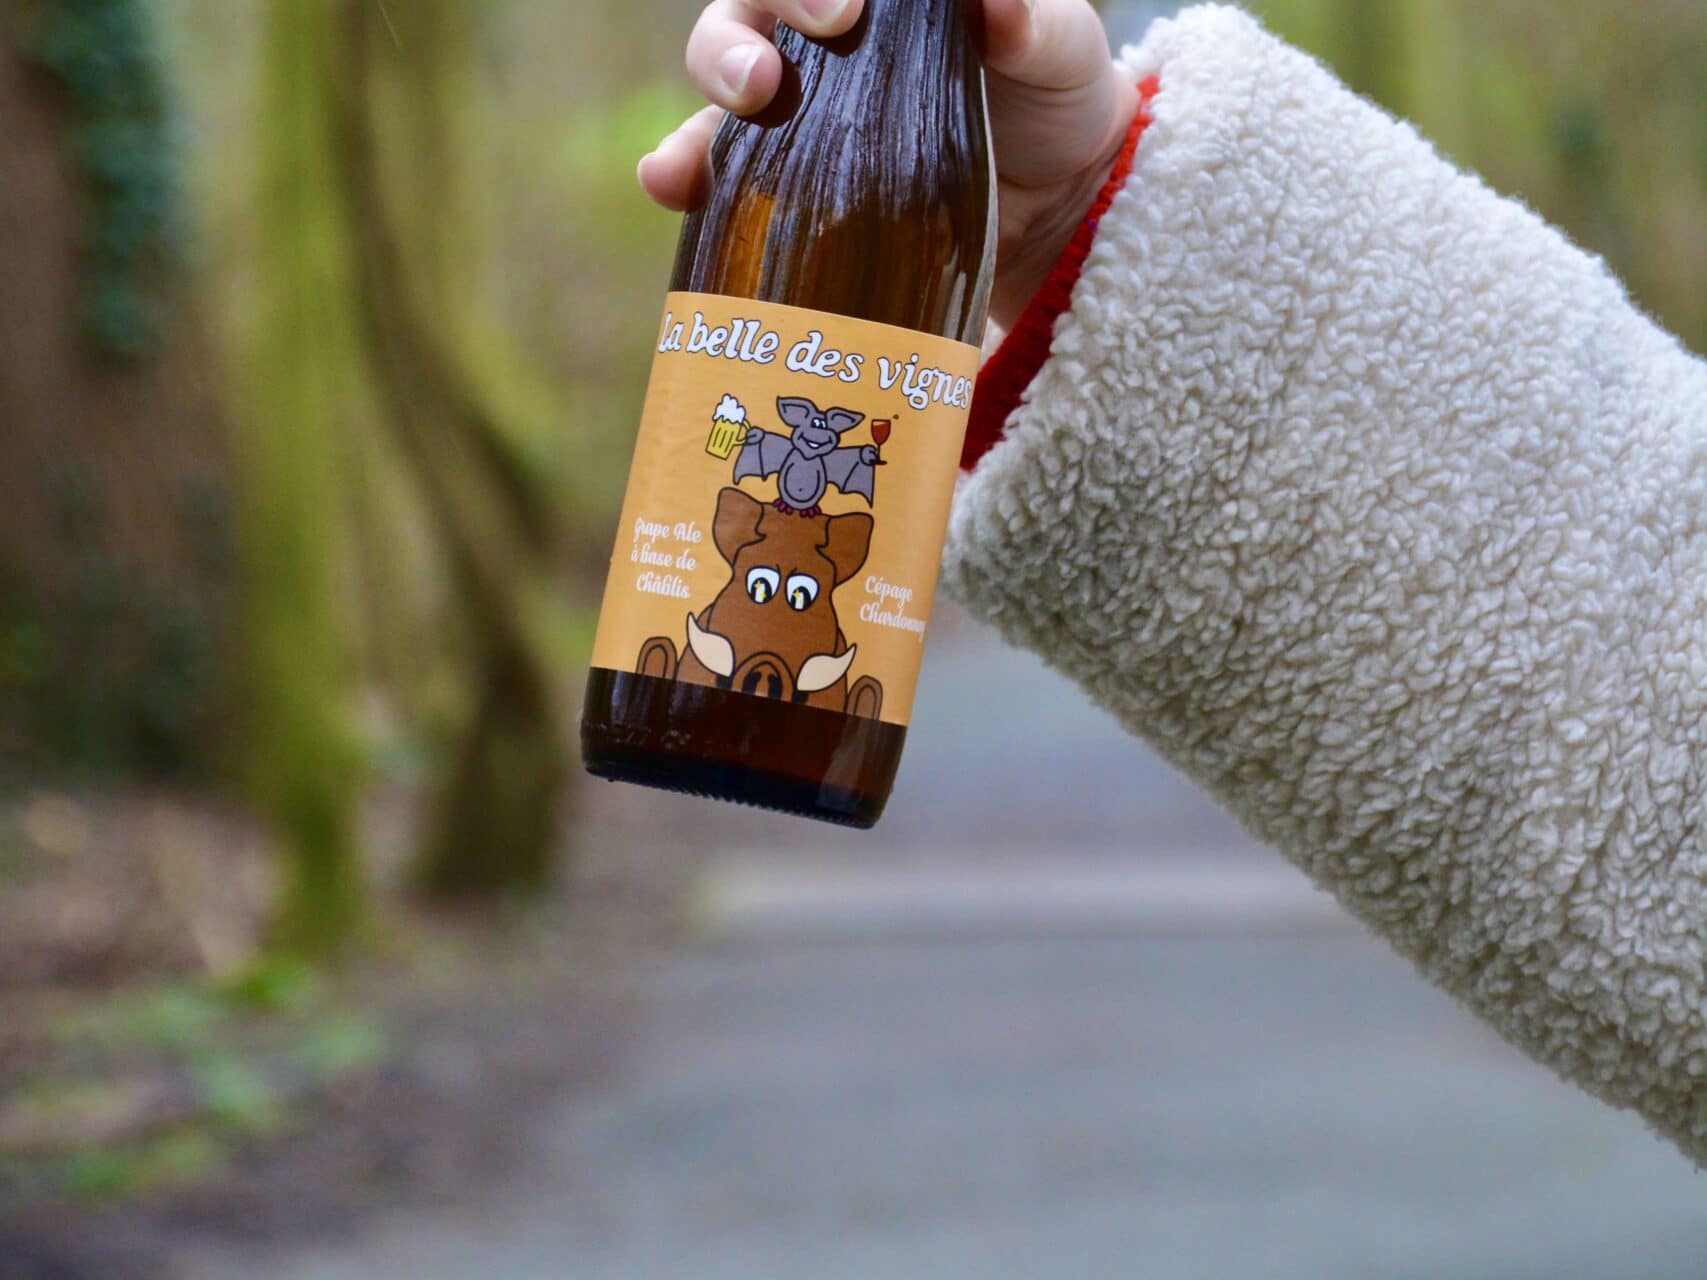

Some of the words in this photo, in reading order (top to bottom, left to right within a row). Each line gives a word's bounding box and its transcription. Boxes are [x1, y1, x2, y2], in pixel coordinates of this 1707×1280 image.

[686, 310, 780, 365] belle
[786, 330, 864, 383] des
[877, 352, 973, 410] vignes
[673, 521, 702, 543] Ale
[640, 543, 673, 567] base
[676, 548, 697, 571] de
[636, 572, 690, 599] Châblis
[860, 602, 925, 643] Chardony
